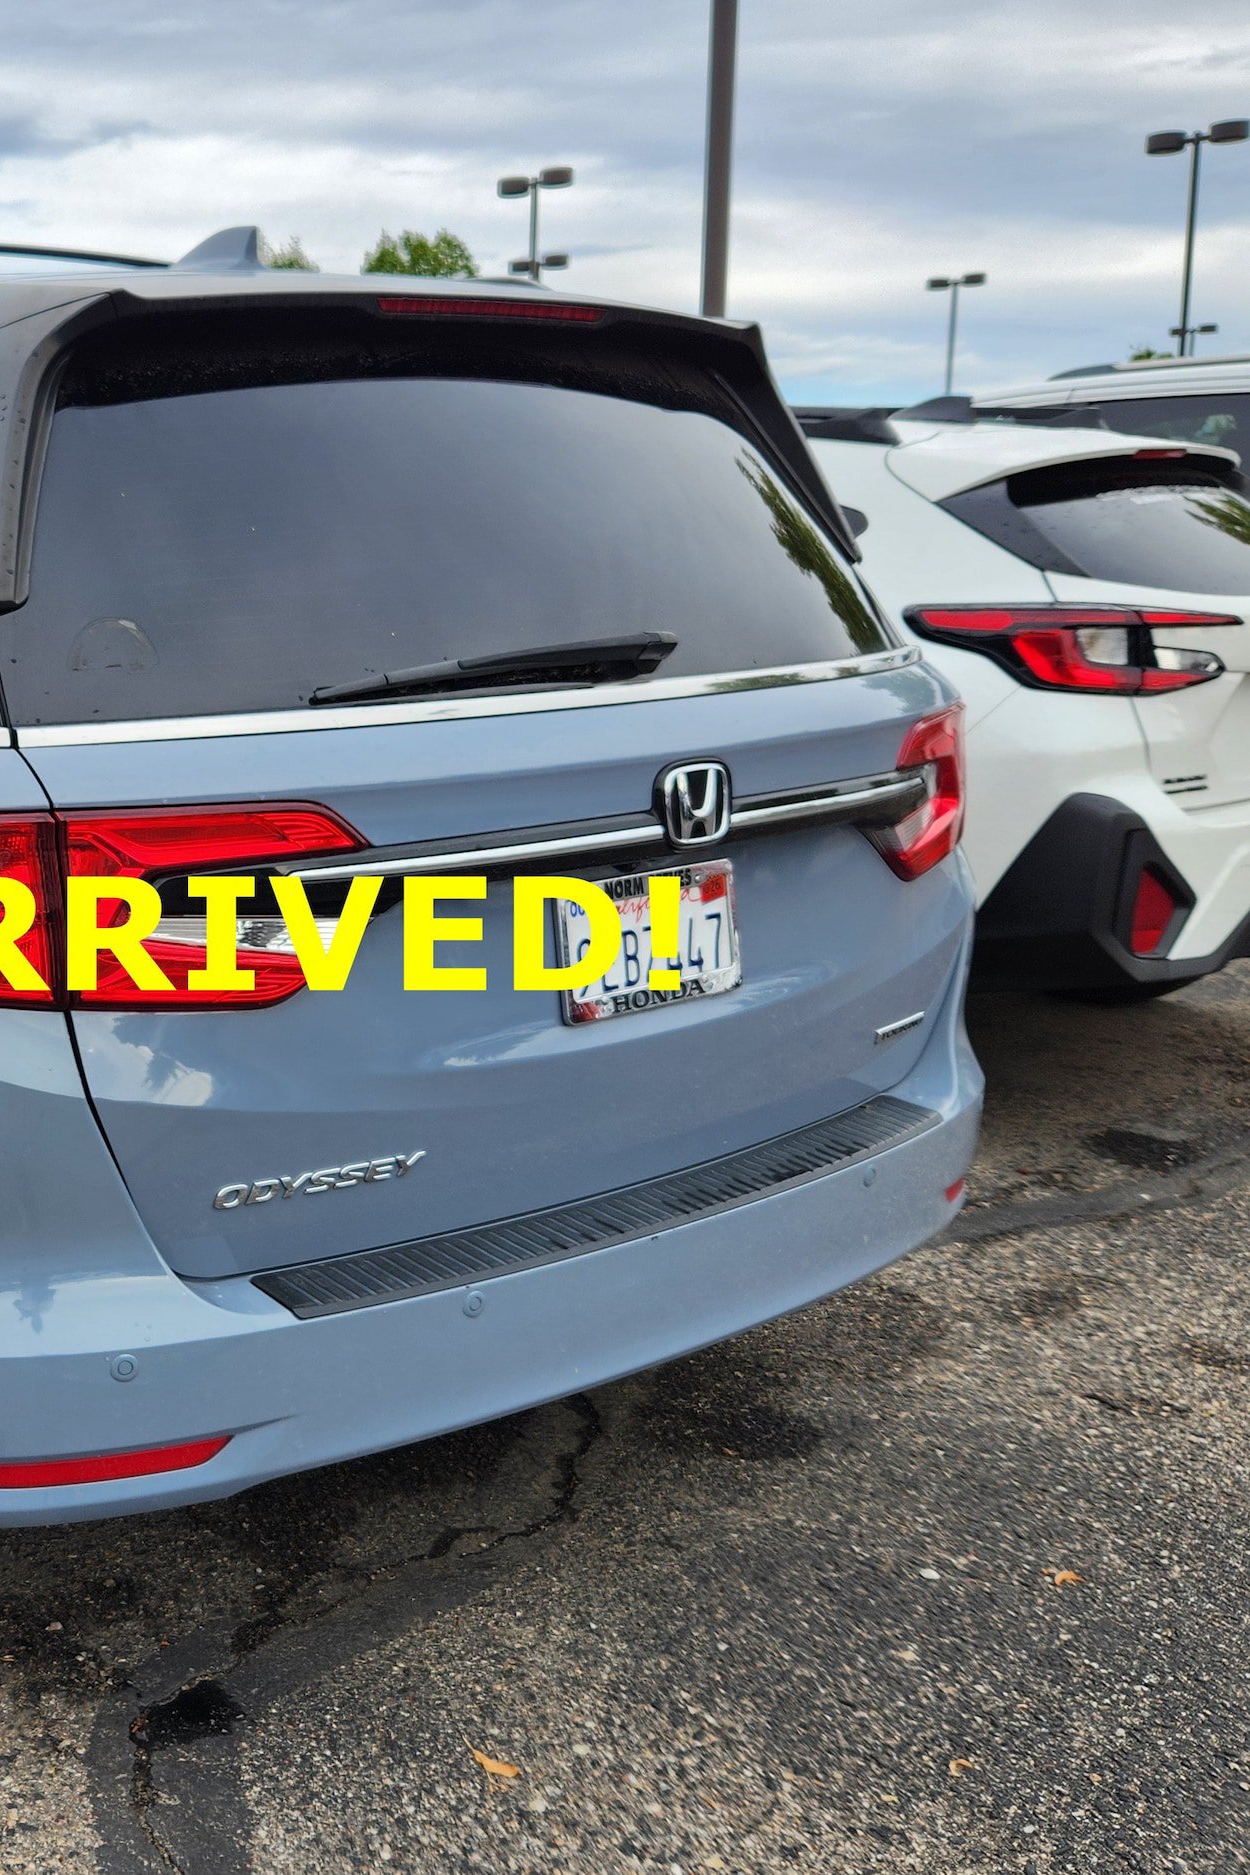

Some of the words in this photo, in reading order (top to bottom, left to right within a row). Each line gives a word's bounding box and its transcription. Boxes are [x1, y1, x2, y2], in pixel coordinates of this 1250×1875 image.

[604, 876, 645, 900] NORM
[614, 979, 706, 1014] HONDA
[213, 1150, 428, 1210] ODYSSEY
